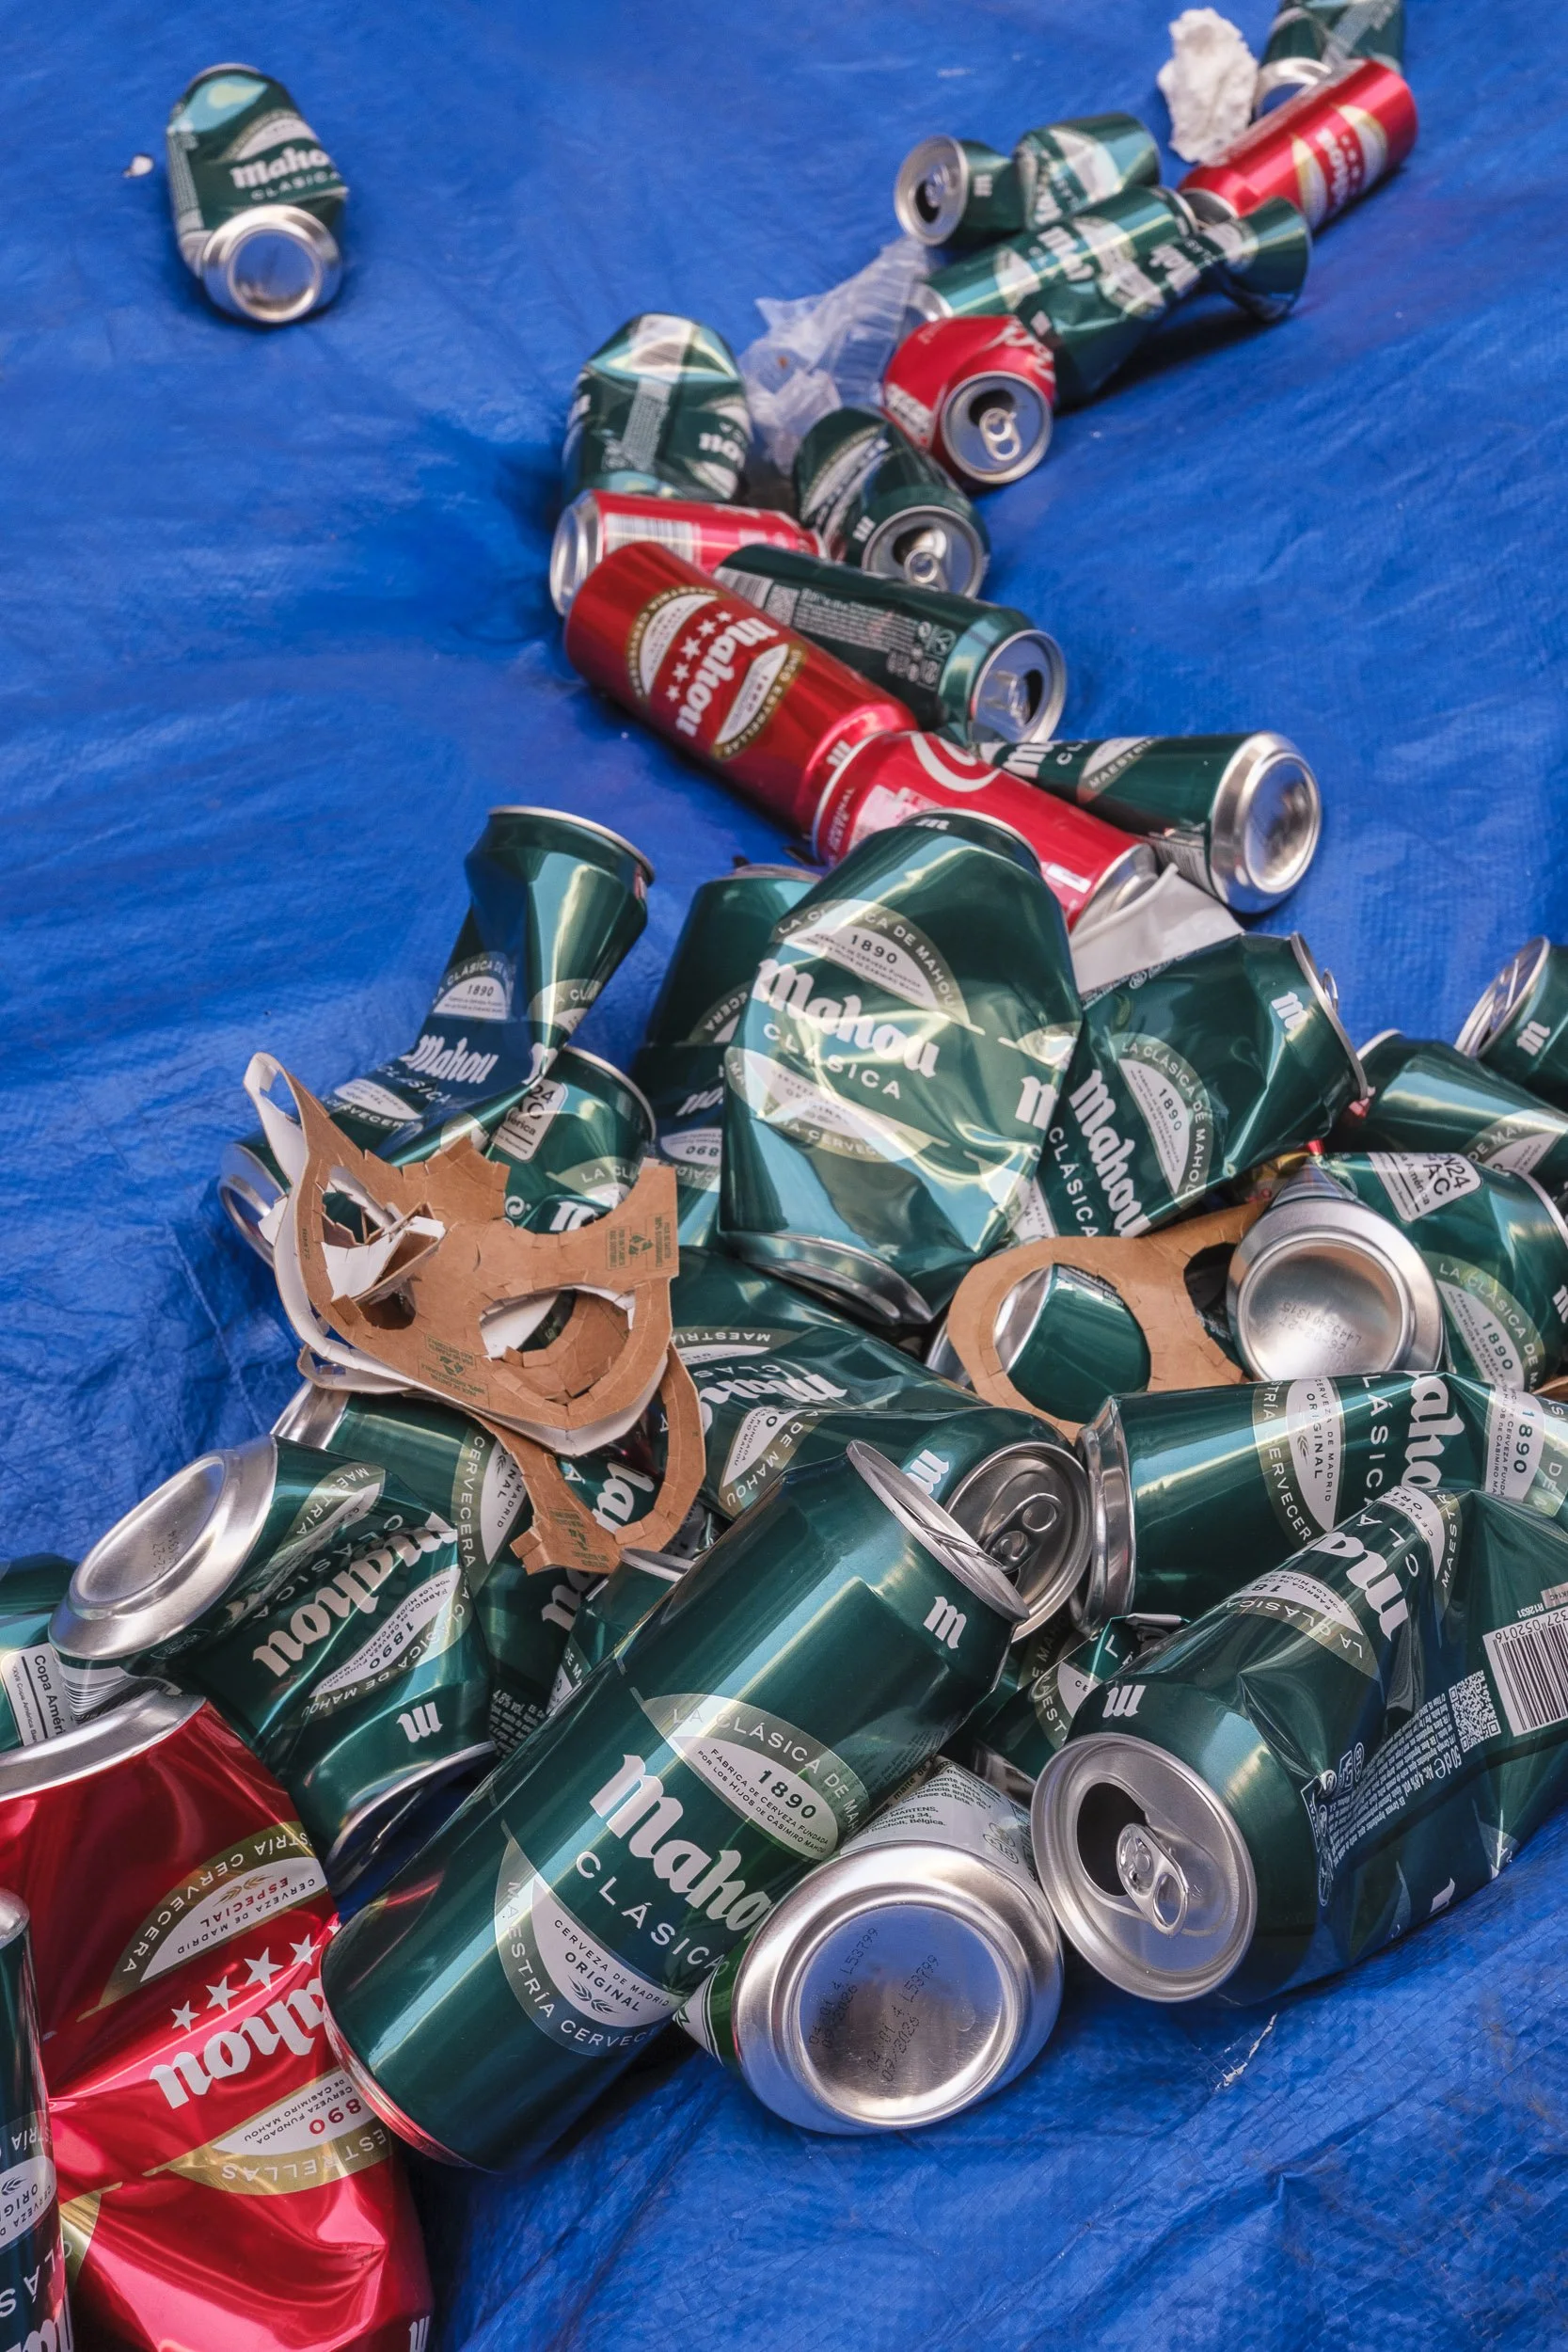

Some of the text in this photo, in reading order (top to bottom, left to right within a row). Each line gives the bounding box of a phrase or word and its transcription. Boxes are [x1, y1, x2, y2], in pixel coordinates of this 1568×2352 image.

[675, 617, 779, 738] Mahou
[850, 935, 897, 964] 1890
[894, 926, 916, 946] DE
[915, 945, 956, 1008] MAHOU
[467, 984, 494, 996] 1890
[752, 958, 940, 1078] Mahou
[399, 1034, 499, 1085] Mahou
[1158, 1088, 1182, 1131] 1890
[686, 1145, 720, 1156] 890
[693, 1364, 782, 1378] CLAS
[1481, 1322, 1513, 1371] 1890
[1524, 1343, 1538, 1367] DE
[1327, 1430, 1335, 1446] DE
[1401, 1375, 1465, 1488] aho
[726, 1422, 803, 1506] DE MAHOU
[1263, 1379, 1313, 1545] STRÍA CERVECER
[1324, 1452, 1334, 1502] MADRID
[459, 1436, 486, 1567] CERVECERA
[1496, 1612, 1568, 1643] 052016 327
[1516, 1603, 1544, 1619] R12631
[369, 1621, 414, 1670] 1890
[1339, 1633, 1362, 1658] LA
[34, 1655, 66, 1735] Copa Améri
[673, 1708, 704, 1724] LA
[716, 1713, 821, 1773] CLÁSICA
[824, 1772, 849, 1799] DE
[843, 1799, 860, 1830] MAH
[697, 1750, 713, 1767] POR
[713, 1766, 728, 1782] LOS
[730, 1781, 754, 1806] HIJOS
[755, 1806, 765, 1816] DE
[767, 1816, 804, 1843] CASIMIRO
[710, 1748, 829, 1845] FÁBRICA DE CERVEZA FUNDADA
[757, 1770, 816, 1819] 1890
[589, 1753, 776, 1931] Maho
[123, 1832, 310, 1974] STRÍA CERVECERA
[177, 1878, 316, 1955] CERVEZA DE MADRID
[199, 1878, 290, 1928] ESPECIAL
[575, 1850, 726, 1974] CLÁSICA
[507, 1882, 557, 2019] MAESTRÍA
[553, 1918, 671, 2008] CERVEZA DE MADRID
[563, 1951, 641, 2012] ORIGINAL
[243, 2116, 282, 2143] MAHOU
[256, 2086, 354, 2145] CERVEZA FUNDADA
[284, 2085, 333, 2119] CASIMIRO
[308, 2098, 363, 2137] 890
